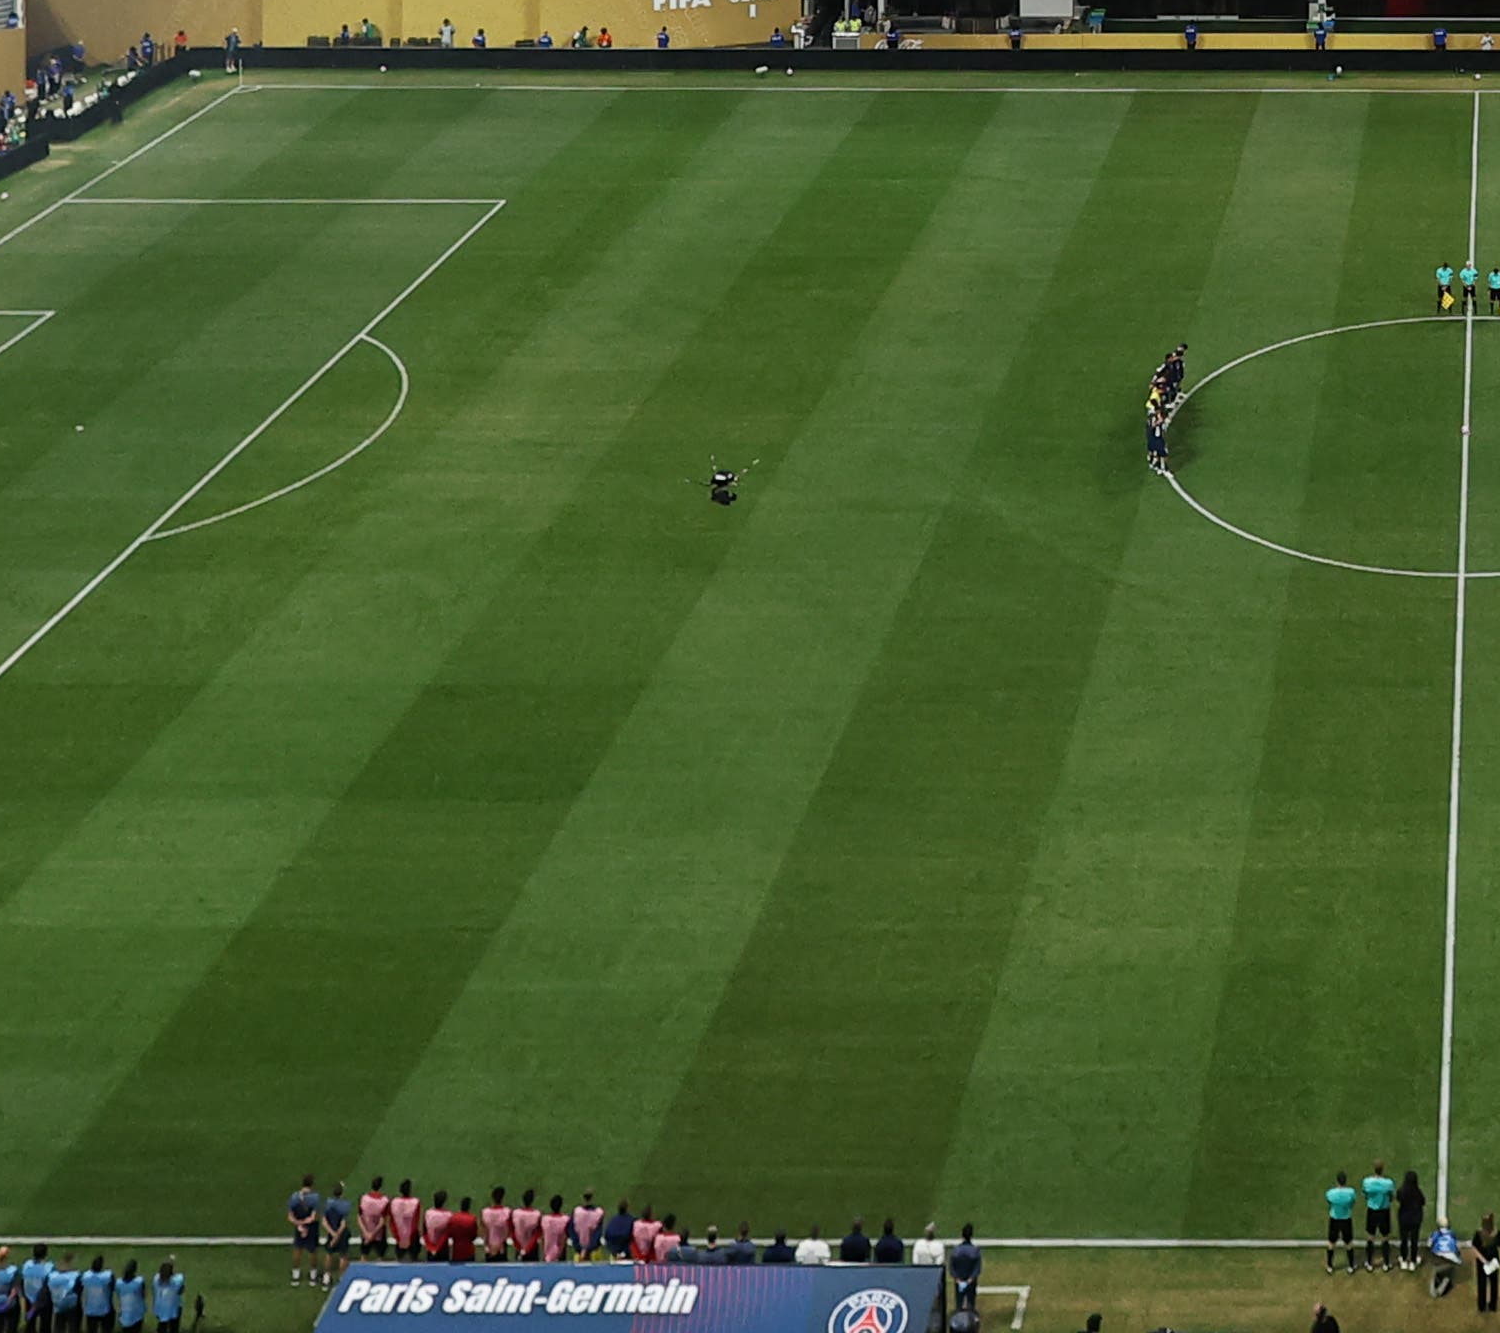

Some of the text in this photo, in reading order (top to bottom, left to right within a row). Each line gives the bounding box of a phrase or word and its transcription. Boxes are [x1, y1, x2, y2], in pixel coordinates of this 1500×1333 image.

[338, 1277, 700, 1316] Paris Saint-Germain
[848, 1290, 898, 1310] PARIS
